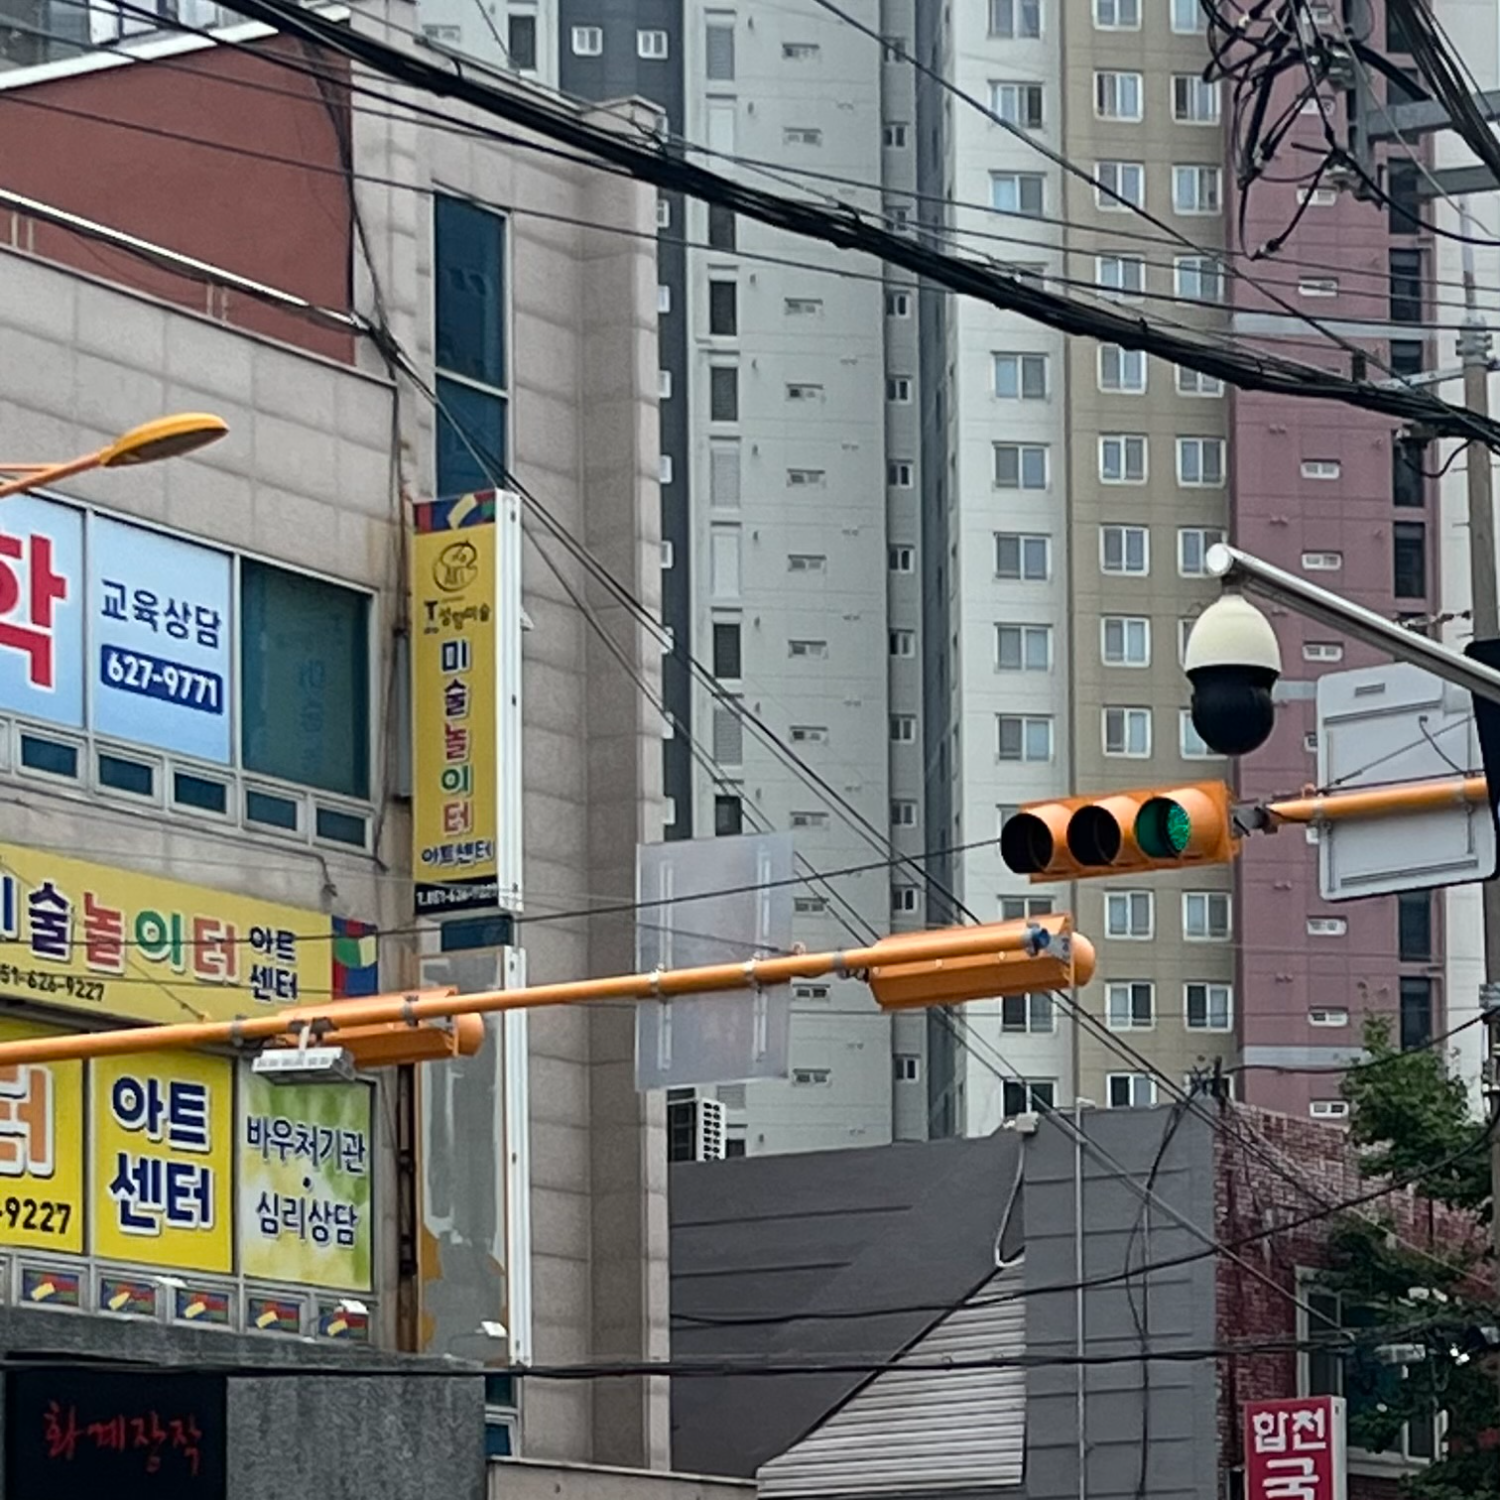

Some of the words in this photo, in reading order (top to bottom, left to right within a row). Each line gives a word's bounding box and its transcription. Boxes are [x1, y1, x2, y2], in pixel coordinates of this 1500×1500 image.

[101, 578, 222, 649] 교육상담
[107, 651, 219, 708] 627-9771
[440, 640, 472, 834] 미술놀이터
[421, 840, 494, 865] 아트센터
[249, 924, 297, 962] 아트
[249, 966, 298, 1001] 센터
[112, 1076, 211, 1152] 아트
[246, 1114, 367, 1174] 바우처기관
[109, 1152, 213, 1235] 센터
[255, 1196, 359, 1247] 심리상담
[1252, 1407, 1327, 1454] 합천
